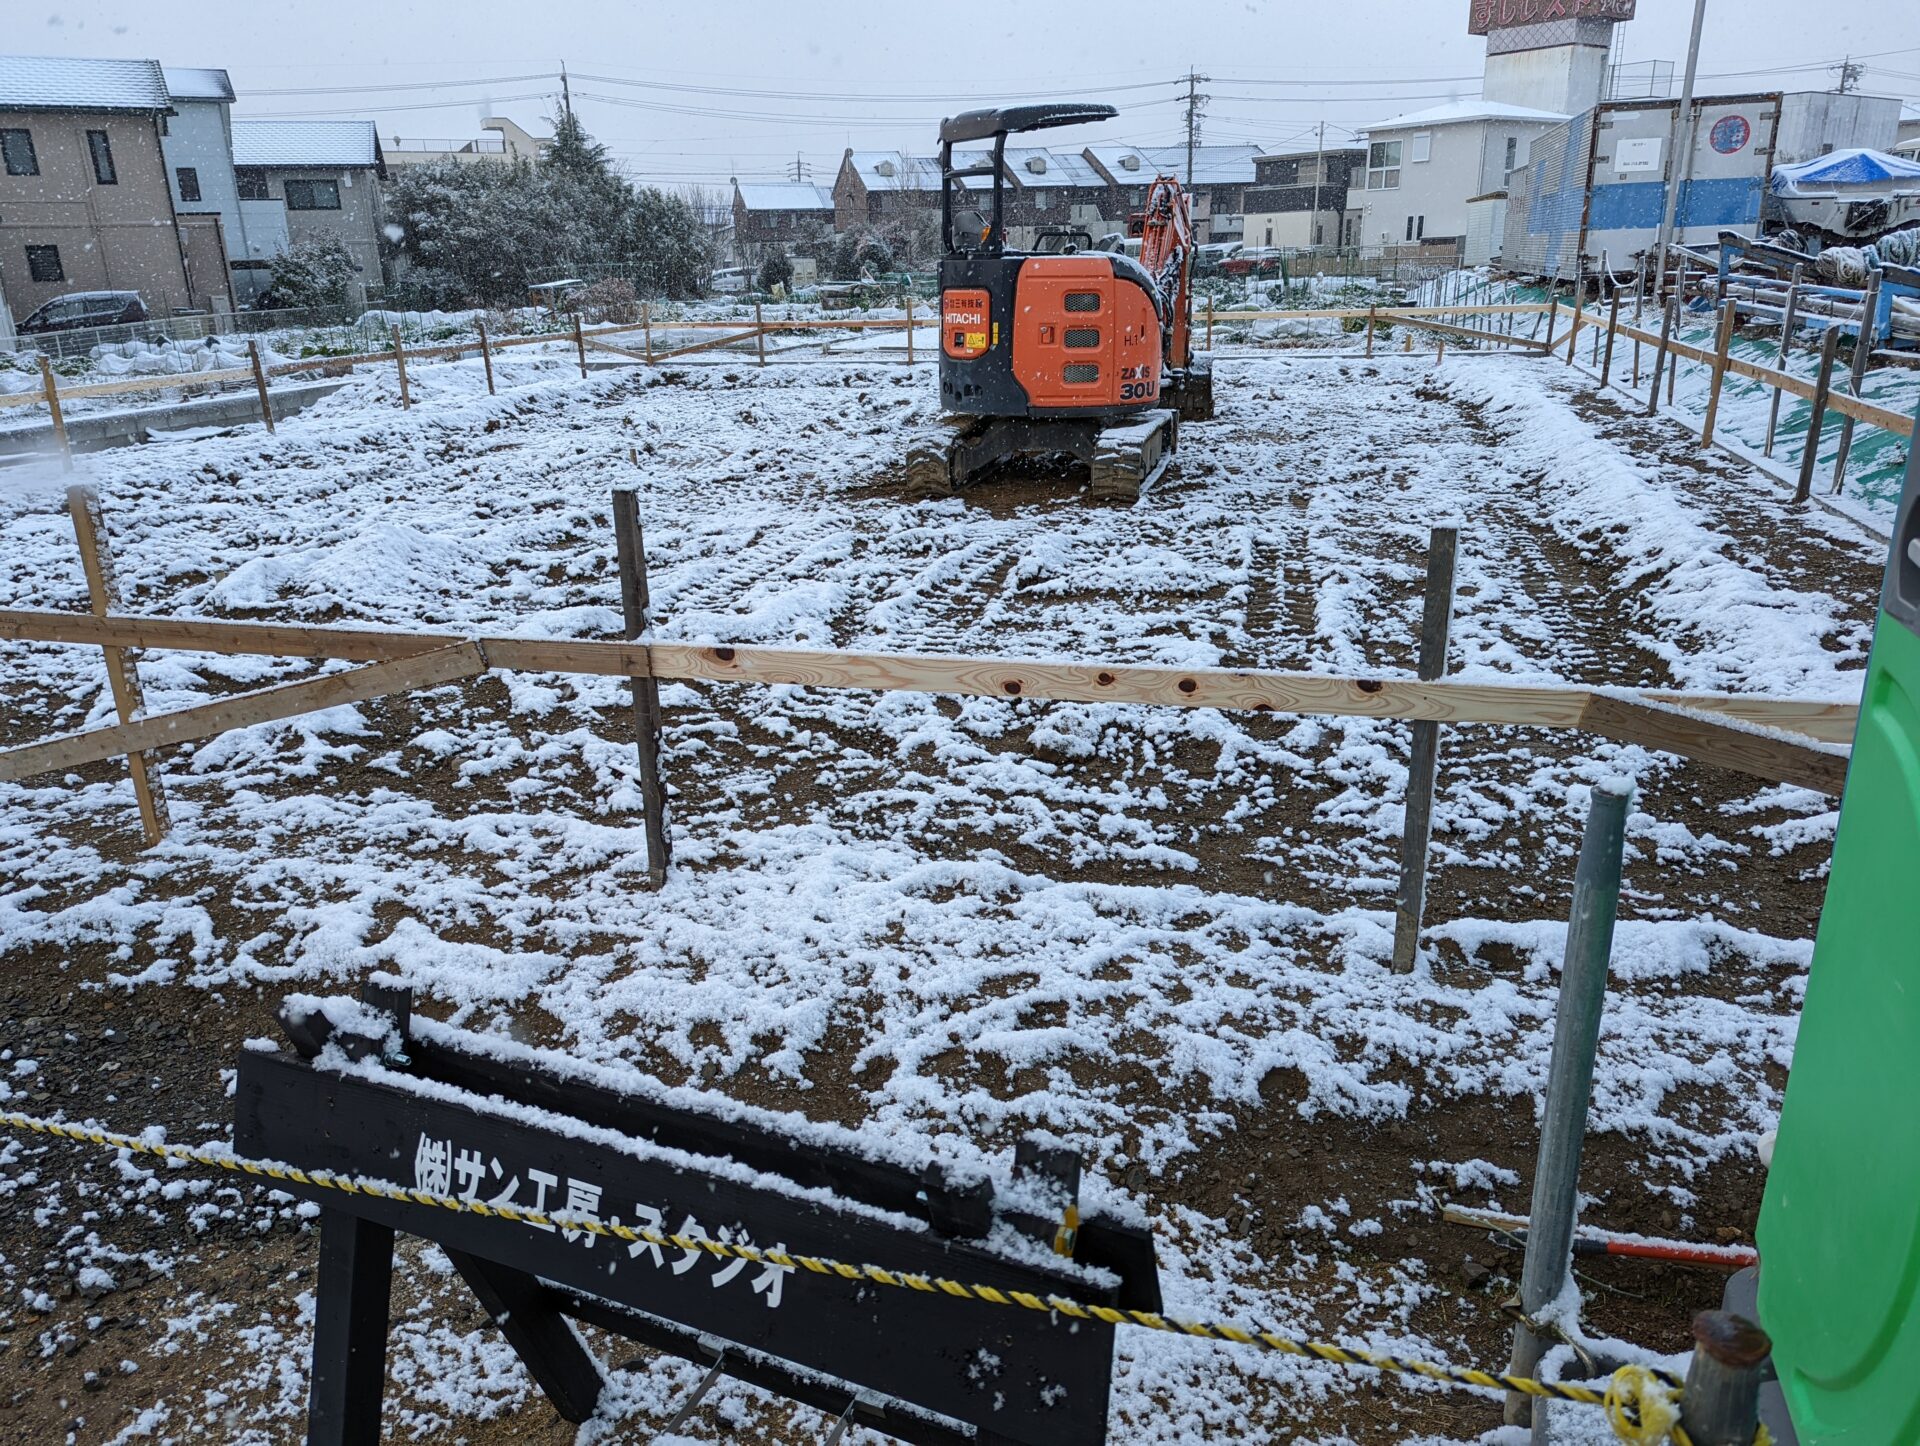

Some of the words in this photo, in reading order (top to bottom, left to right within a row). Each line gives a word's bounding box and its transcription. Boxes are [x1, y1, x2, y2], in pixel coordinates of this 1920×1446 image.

[945, 312, 981, 325] HITACHI
[1121, 366, 1150, 380] ZAXIS
[1120, 380, 1155, 400] 30U
